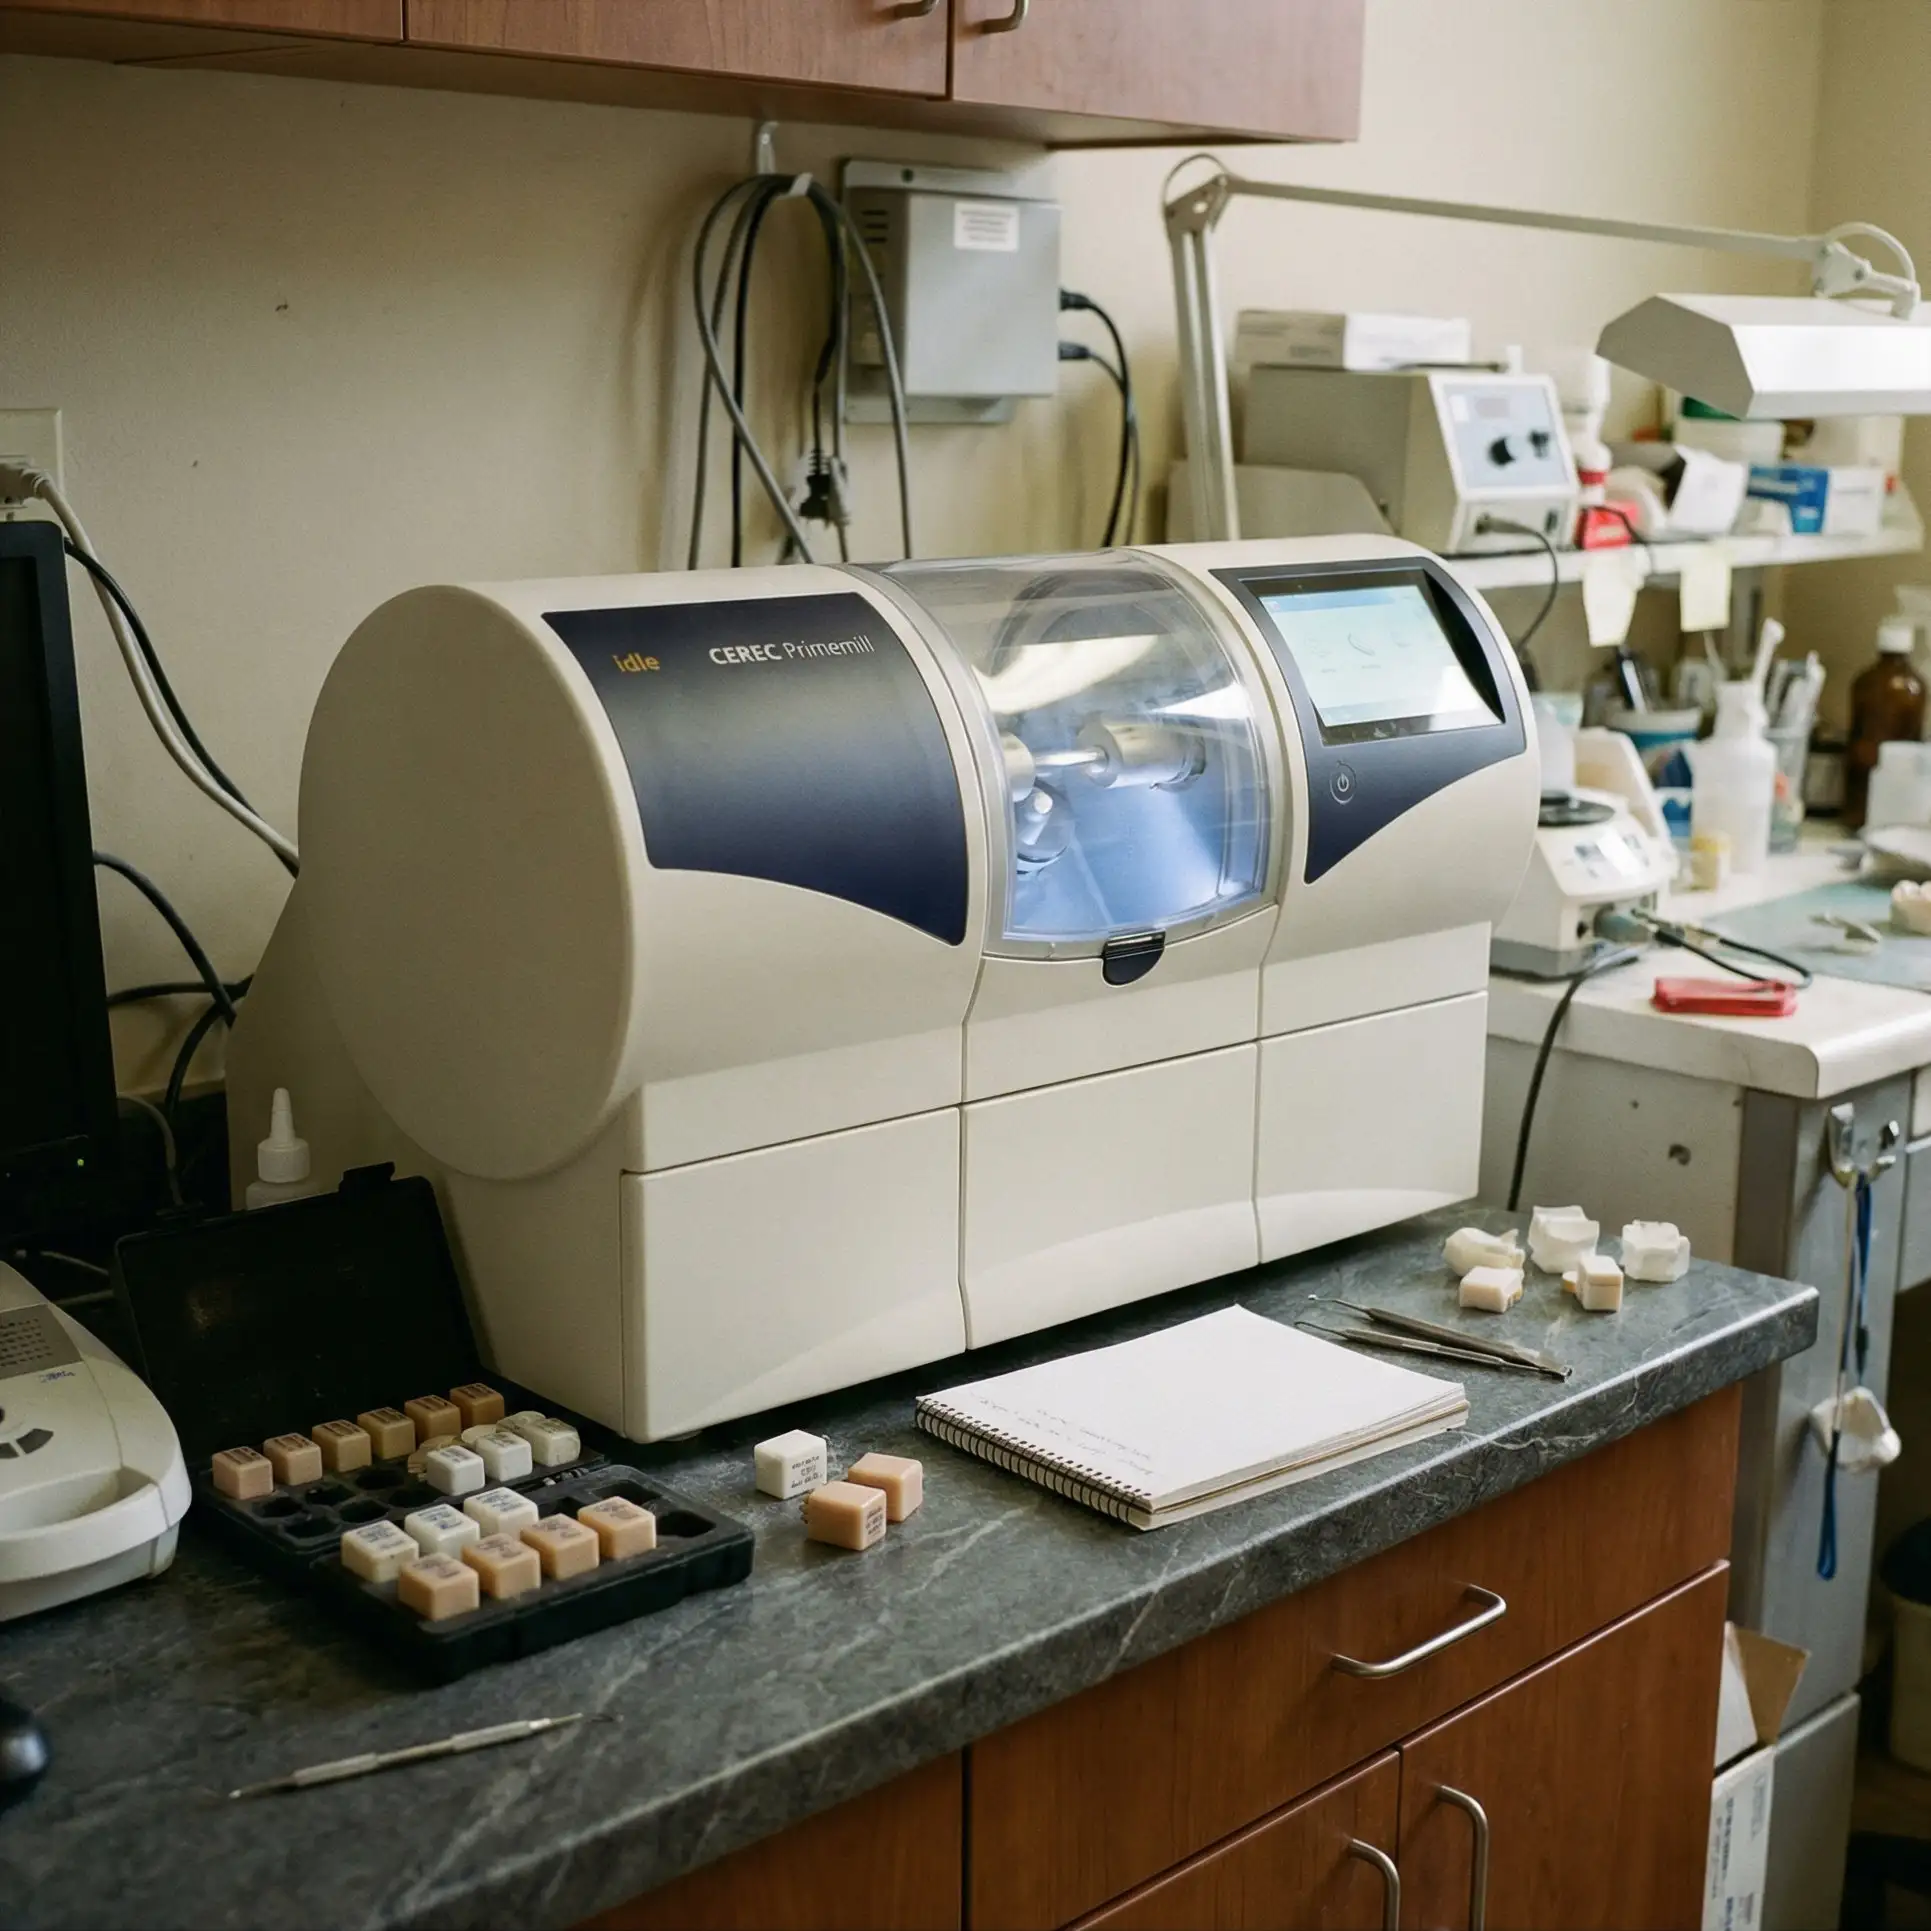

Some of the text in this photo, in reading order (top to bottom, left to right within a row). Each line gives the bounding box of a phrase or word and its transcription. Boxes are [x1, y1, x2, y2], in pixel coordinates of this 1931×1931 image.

[709, 635, 875, 665] CEREC Primemill
[613, 653, 661, 673] idle
